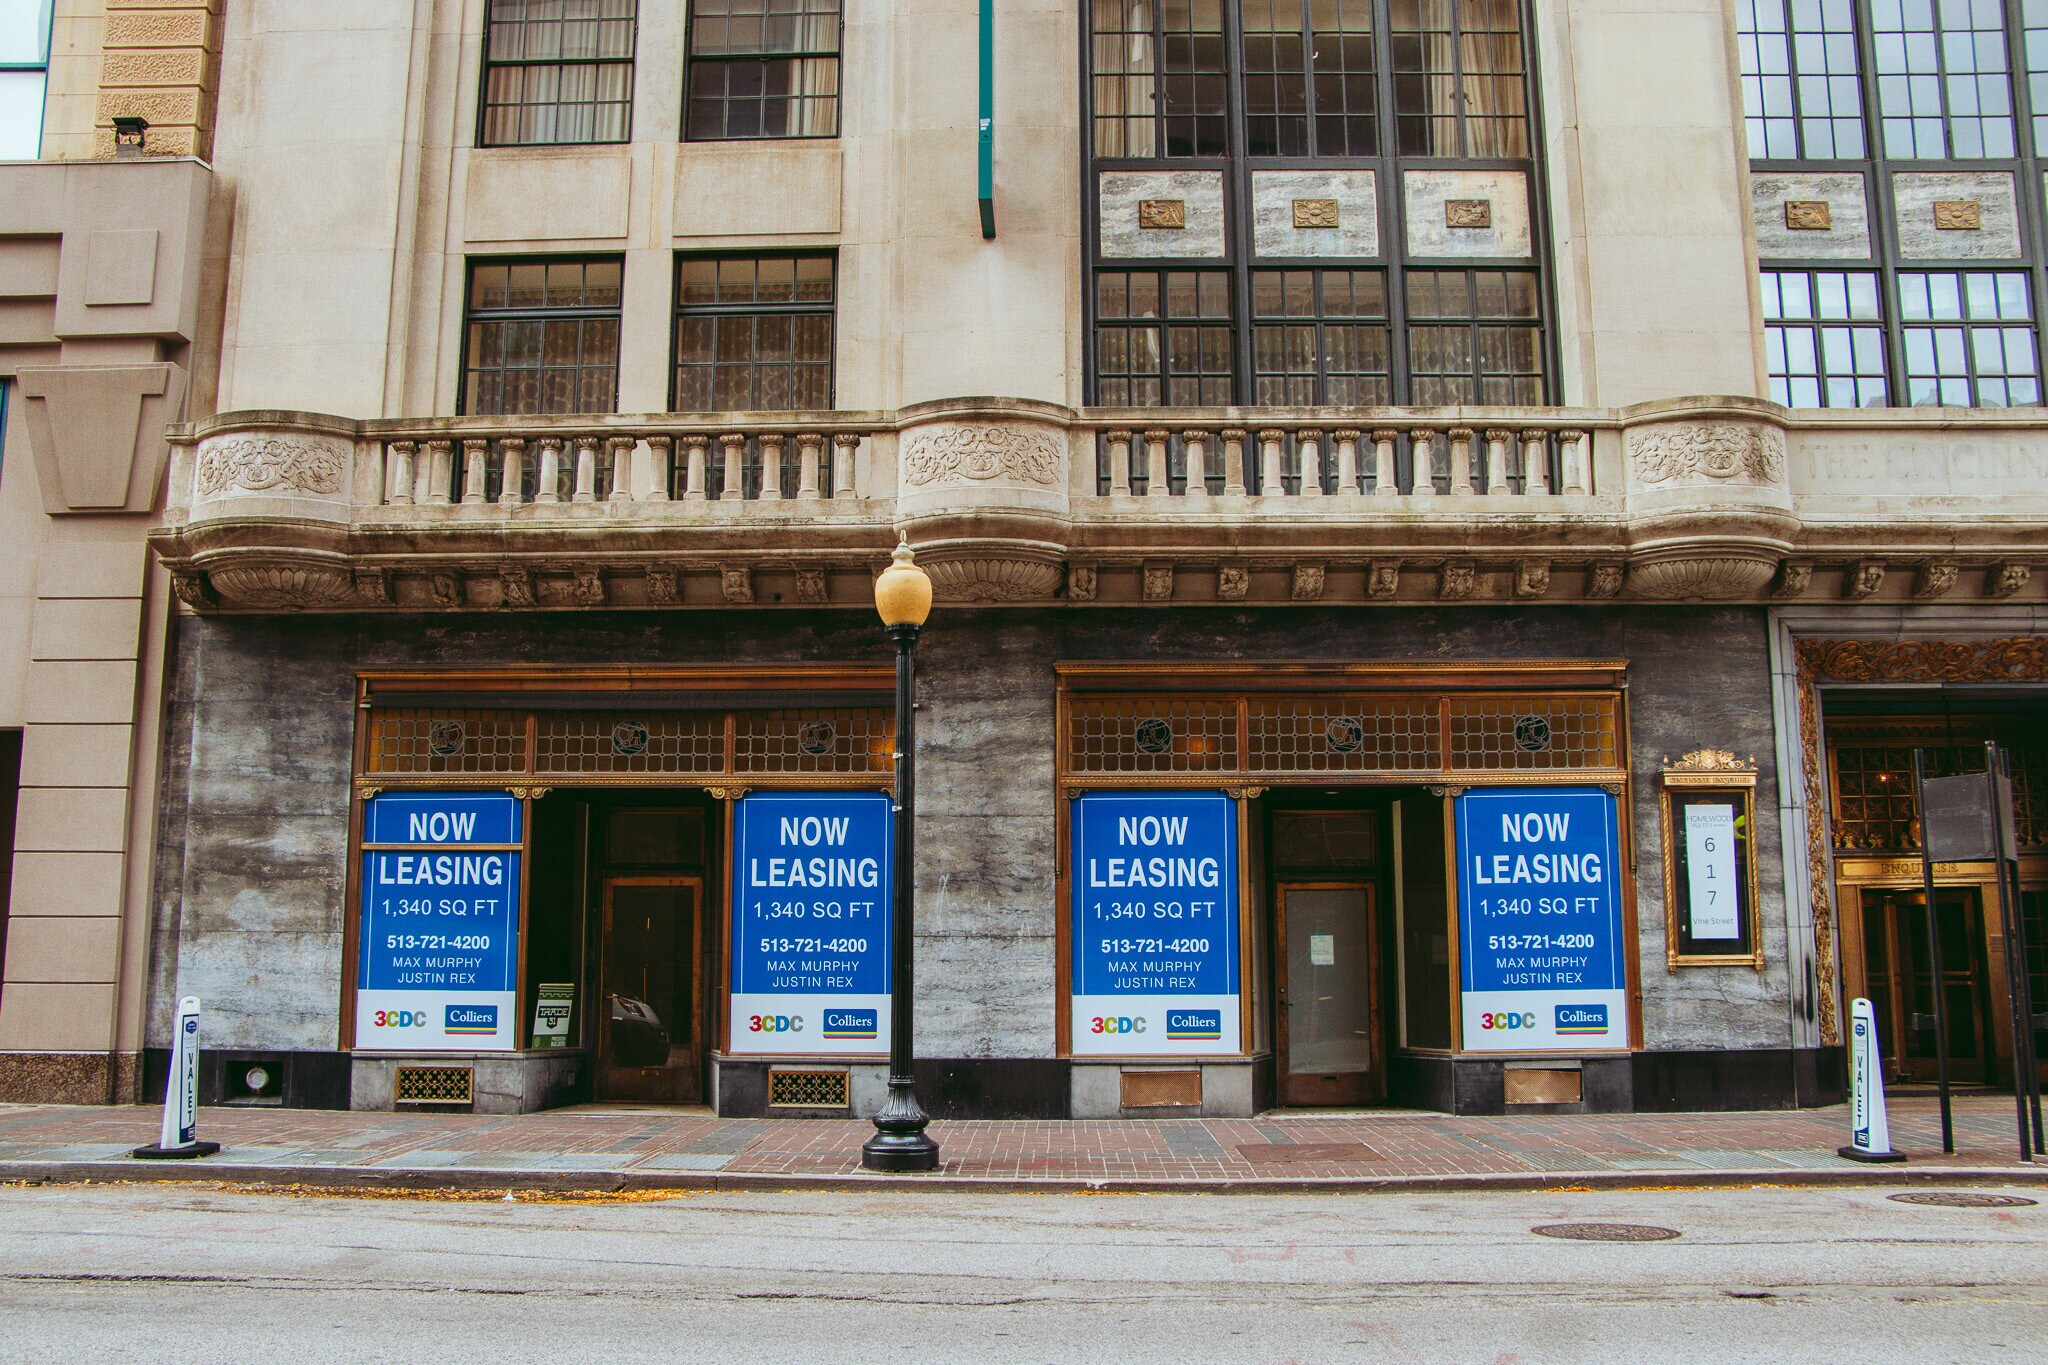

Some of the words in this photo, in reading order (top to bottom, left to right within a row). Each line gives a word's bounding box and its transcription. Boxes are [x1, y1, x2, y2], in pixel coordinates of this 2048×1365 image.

[1686, 815, 1731, 823] HOMEWOOD
[410, 812, 476, 841] NOW
[781, 817, 849, 846] NOW
[1120, 816, 1188, 845] NOW
[1503, 813, 1569, 842] NOW
[380, 856, 501, 885] LEASING
[752, 858, 877, 887] LEASING
[1091, 858, 1218, 887] LEASING
[1476, 854, 1601, 884] LEASING
[383, 899, 431, 917] 1,340
[439, 900, 466, 915] SQ
[475, 900, 498, 915] FT
[754, 902, 804, 920] 1,340
[813, 902, 841, 918] SQ
[850, 903, 874, 917] FT
[1094, 903, 1145, 920] 1,340
[1154, 902, 1182, 918] SQ
[1191, 902, 1215, 917] FT
[1481, 899, 1531, 917] 1,340
[1539, 898, 1567, 914] SQ
[1576, 898, 1599, 913] FT
[1693, 917, 1709, 925] Vine
[1710, 917, 1734, 925] Street
[387, 935, 489, 949] 513-721-4200
[761, 939, 867, 952] 513-721-4200
[1102, 939, 1209, 953] 513-721-4200
[1490, 934, 1594, 949] 513-721-4200
[393, 957, 420, 967] MAX
[426, 958, 481, 967] MURPHY
[768, 961, 795, 971] MAX
[802, 961, 859, 971] MURPHY
[1109, 962, 1137, 972] MAX
[1144, 962, 1201, 972] MURPHY
[1497, 958, 1525, 968] MAX
[1531, 957, 1587, 967] MURPHY
[398, 973, 444, 983] JUSTIN
[450, 973, 474, 983] REX
[773, 977, 820, 987] JUSTIN
[828, 977, 852, 987] REX
[1115, 978, 1163, 988] JUSTIN
[1170, 978, 1195, 987] REX
[1503, 973, 1550, 984] JUSTIN
[1557, 973, 1582, 983] REX
[450, 1011, 492, 1022] Colliers
[540, 1007, 569, 1016] TRADE
[1560, 1011, 1602, 1022] Colliers
[374, 1011, 426, 1027] 3CDC
[749, 1015, 803, 1032] 3CDC
[828, 1015, 872, 1026] Colliers
[1091, 1017, 1146, 1033] 3CDC
[1172, 1016, 1215, 1027] Colliers
[1482, 1012, 1535, 1029] 3CDC
